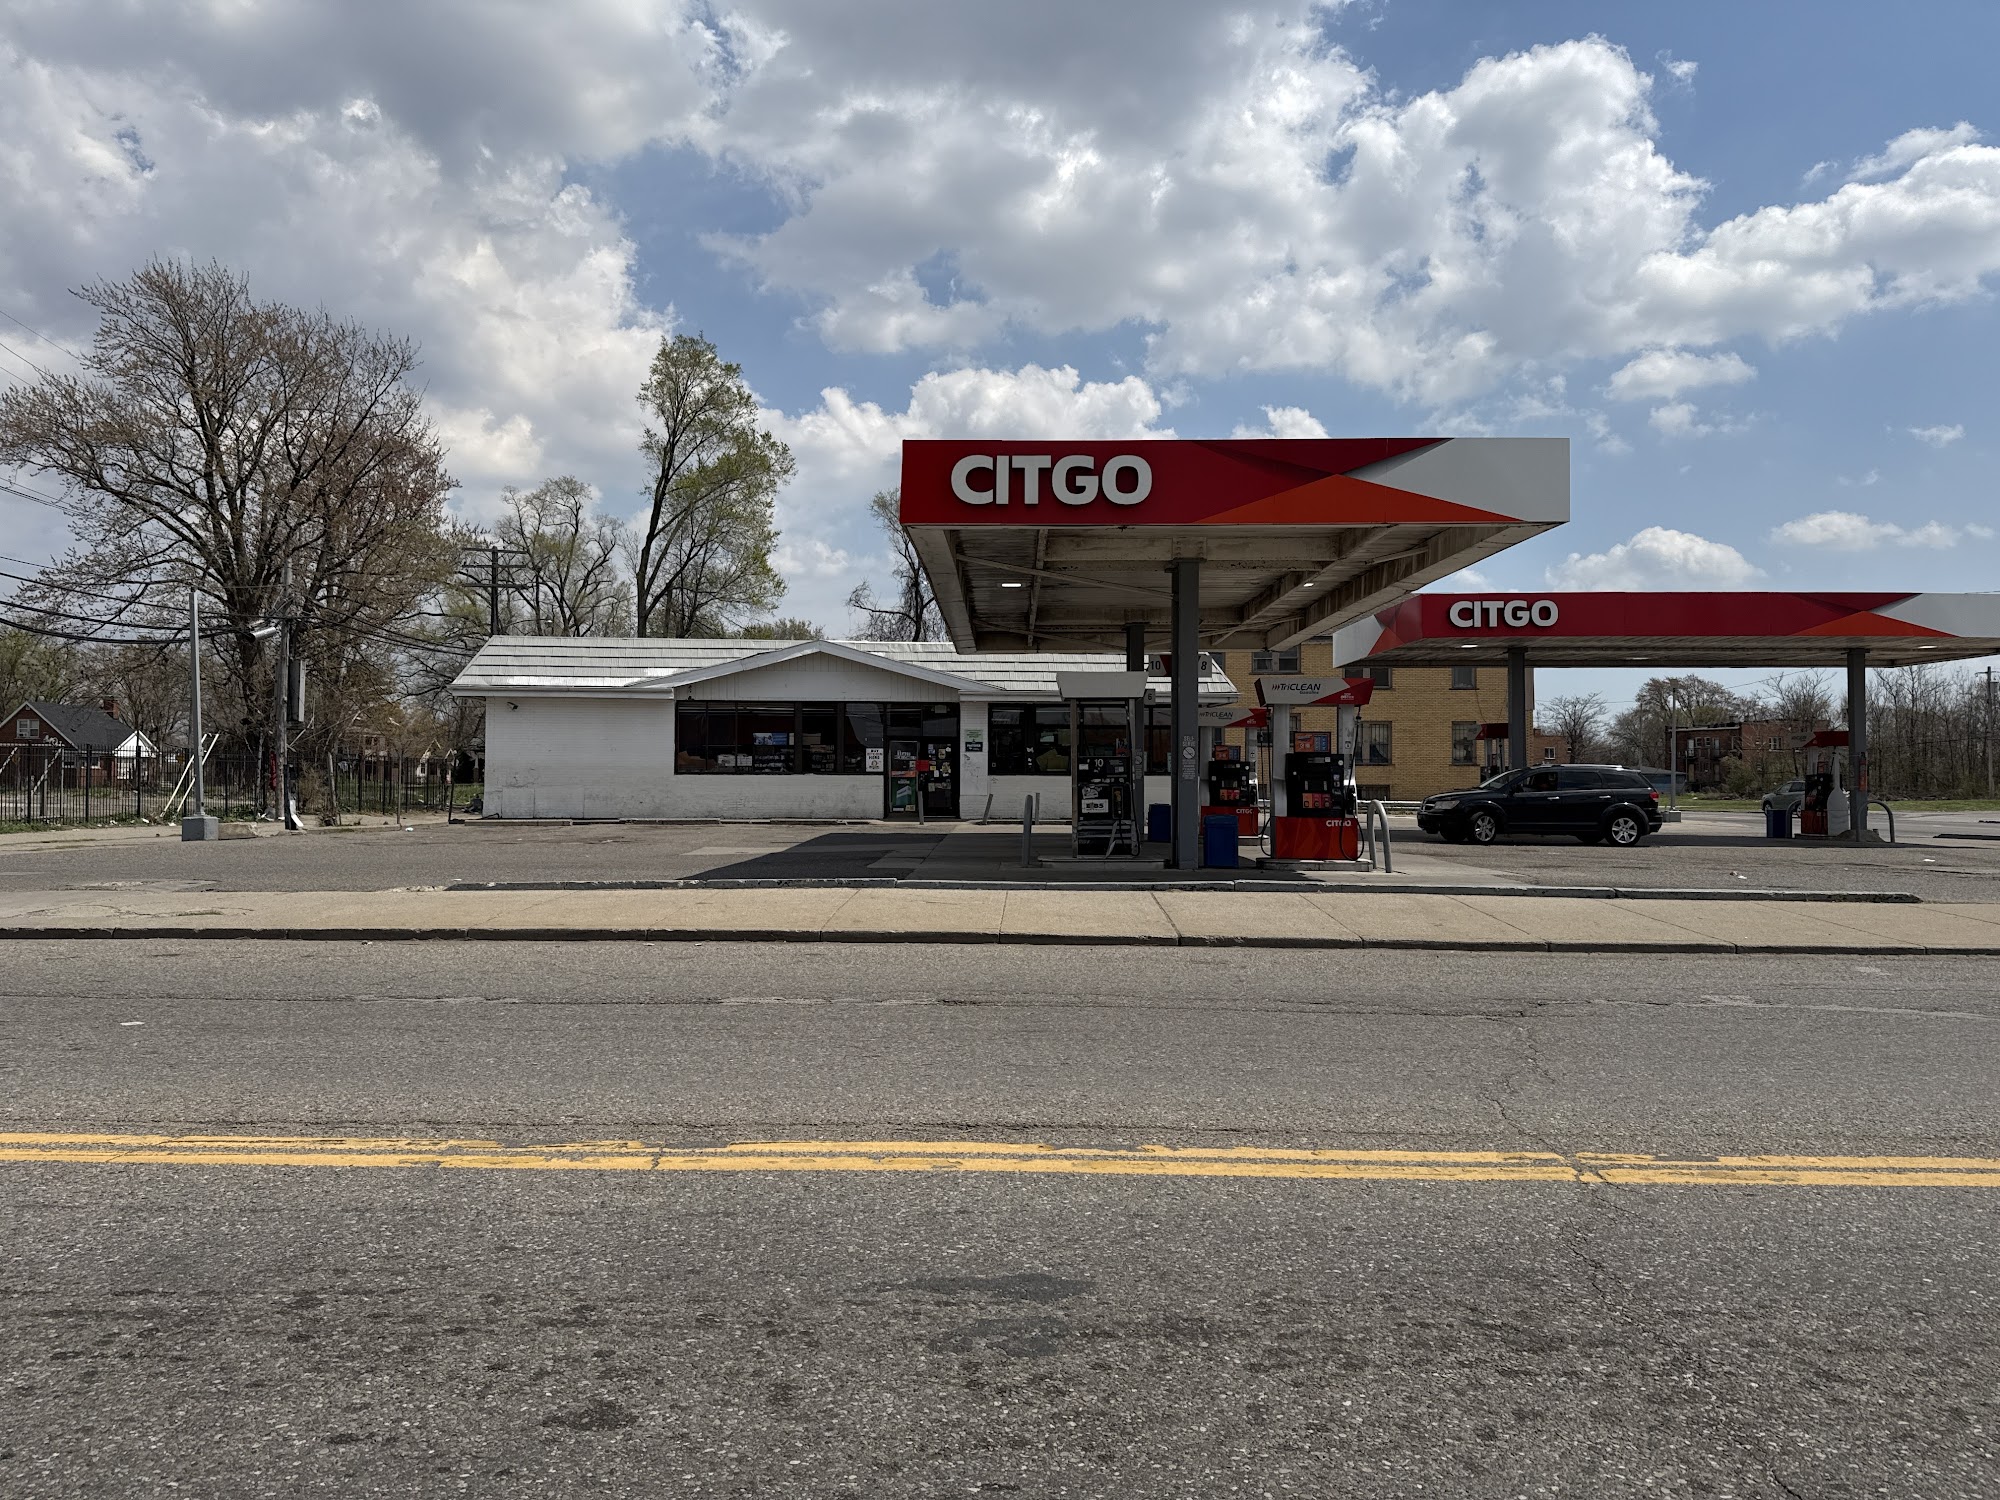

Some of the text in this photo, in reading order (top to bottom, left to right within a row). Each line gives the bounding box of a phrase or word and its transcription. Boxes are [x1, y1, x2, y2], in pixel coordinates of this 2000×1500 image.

[951, 455, 1152, 505] CITGO
[1449, 599, 1559, 628] CITGO
[1150, 660, 1161, 670] 10
[1200, 660, 1208, 671] 8
[1280, 683, 1322, 691] TriCLEAN
[1147, 693, 1153, 701] 6
[1094, 758, 1104, 768] 10
